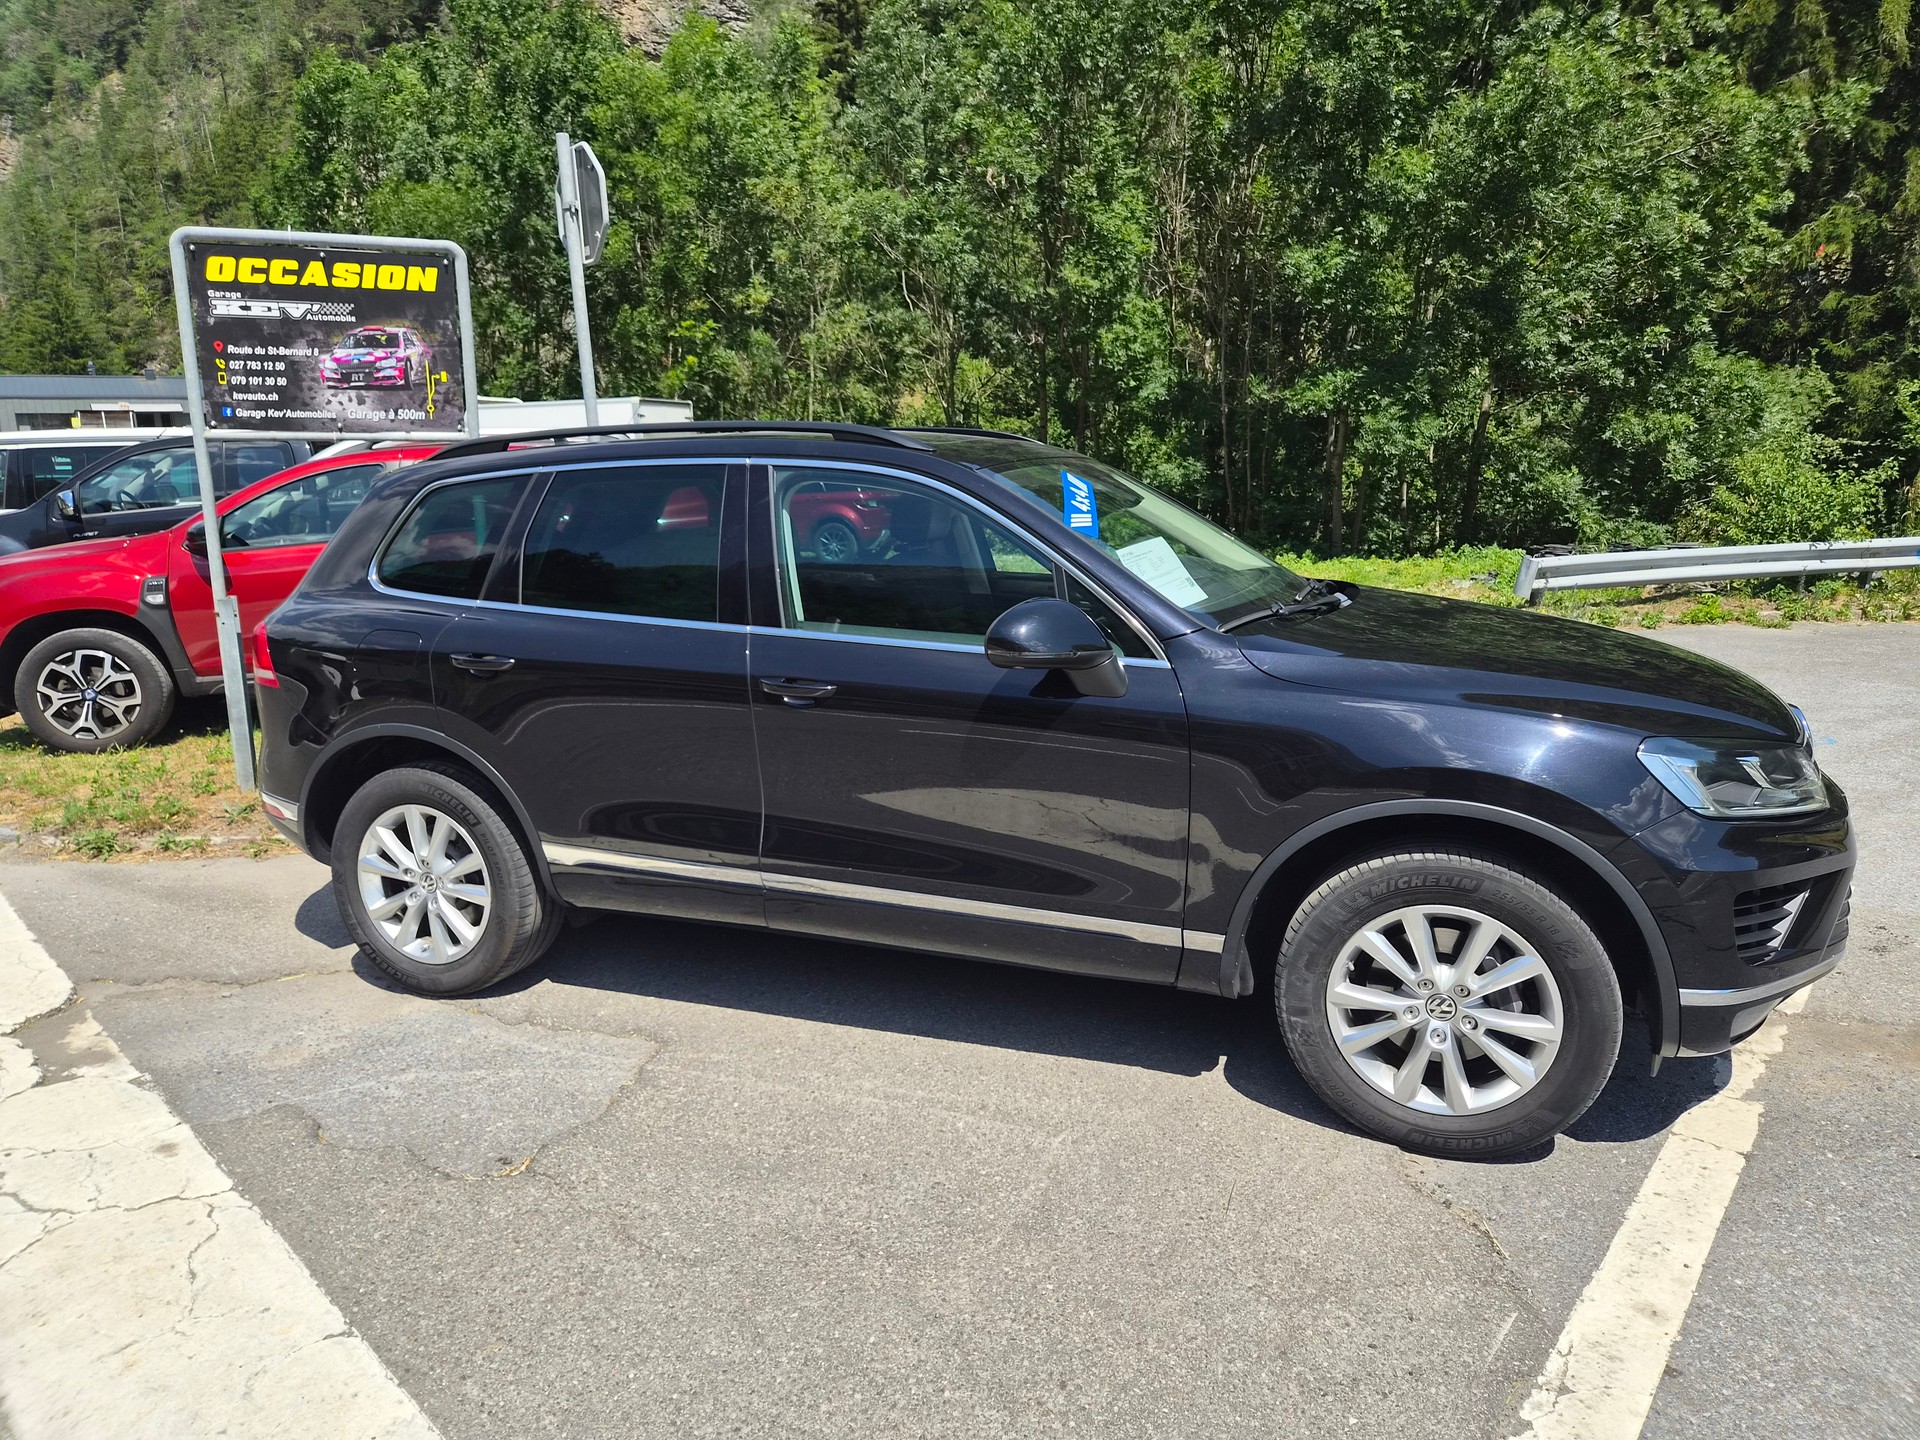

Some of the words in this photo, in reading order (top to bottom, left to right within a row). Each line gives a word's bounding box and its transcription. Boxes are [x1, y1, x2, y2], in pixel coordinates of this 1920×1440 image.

[205, 255, 439, 292] OCCASION
[207, 289, 242, 299] Garage
[306, 313, 356, 323] Automobile
[227, 345, 253, 355] Route
[254, 345, 266, 355] du
[267, 345, 312, 357] St-Bernard
[313, 347, 319, 356] 8
[229, 360, 244, 370] 027
[246, 361, 262, 370] 783
[263, 361, 273, 370] 12
[275, 362, 285, 371] 50
[231, 375, 246, 385] 079
[248, 376, 263, 385] 101
[265, 377, 276, 386] 30
[277, 377, 287, 386] 50
[352, 373, 365, 381] RT
[232, 391, 279, 401] kevauto.ch
[235, 408, 266, 419] Garage
[347, 409, 386, 421] Garage
[388, 409, 395, 420] à
[397, 409, 426, 420] 500m
[418, 782, 479, 825] MICHELIN
[480, 833, 496, 856] PILOT
[494, 861, 507, 890] SPORT
[1369, 874, 1478, 898] MICHELIN
[1492, 889, 1537, 916] 255/55
[1546, 924, 1560, 936] 18
[1323, 1078, 1358, 1109] SPORT
[1358, 1110, 1394, 1132] PILOT
[1408, 1130, 1515, 1149] MICHELIN
